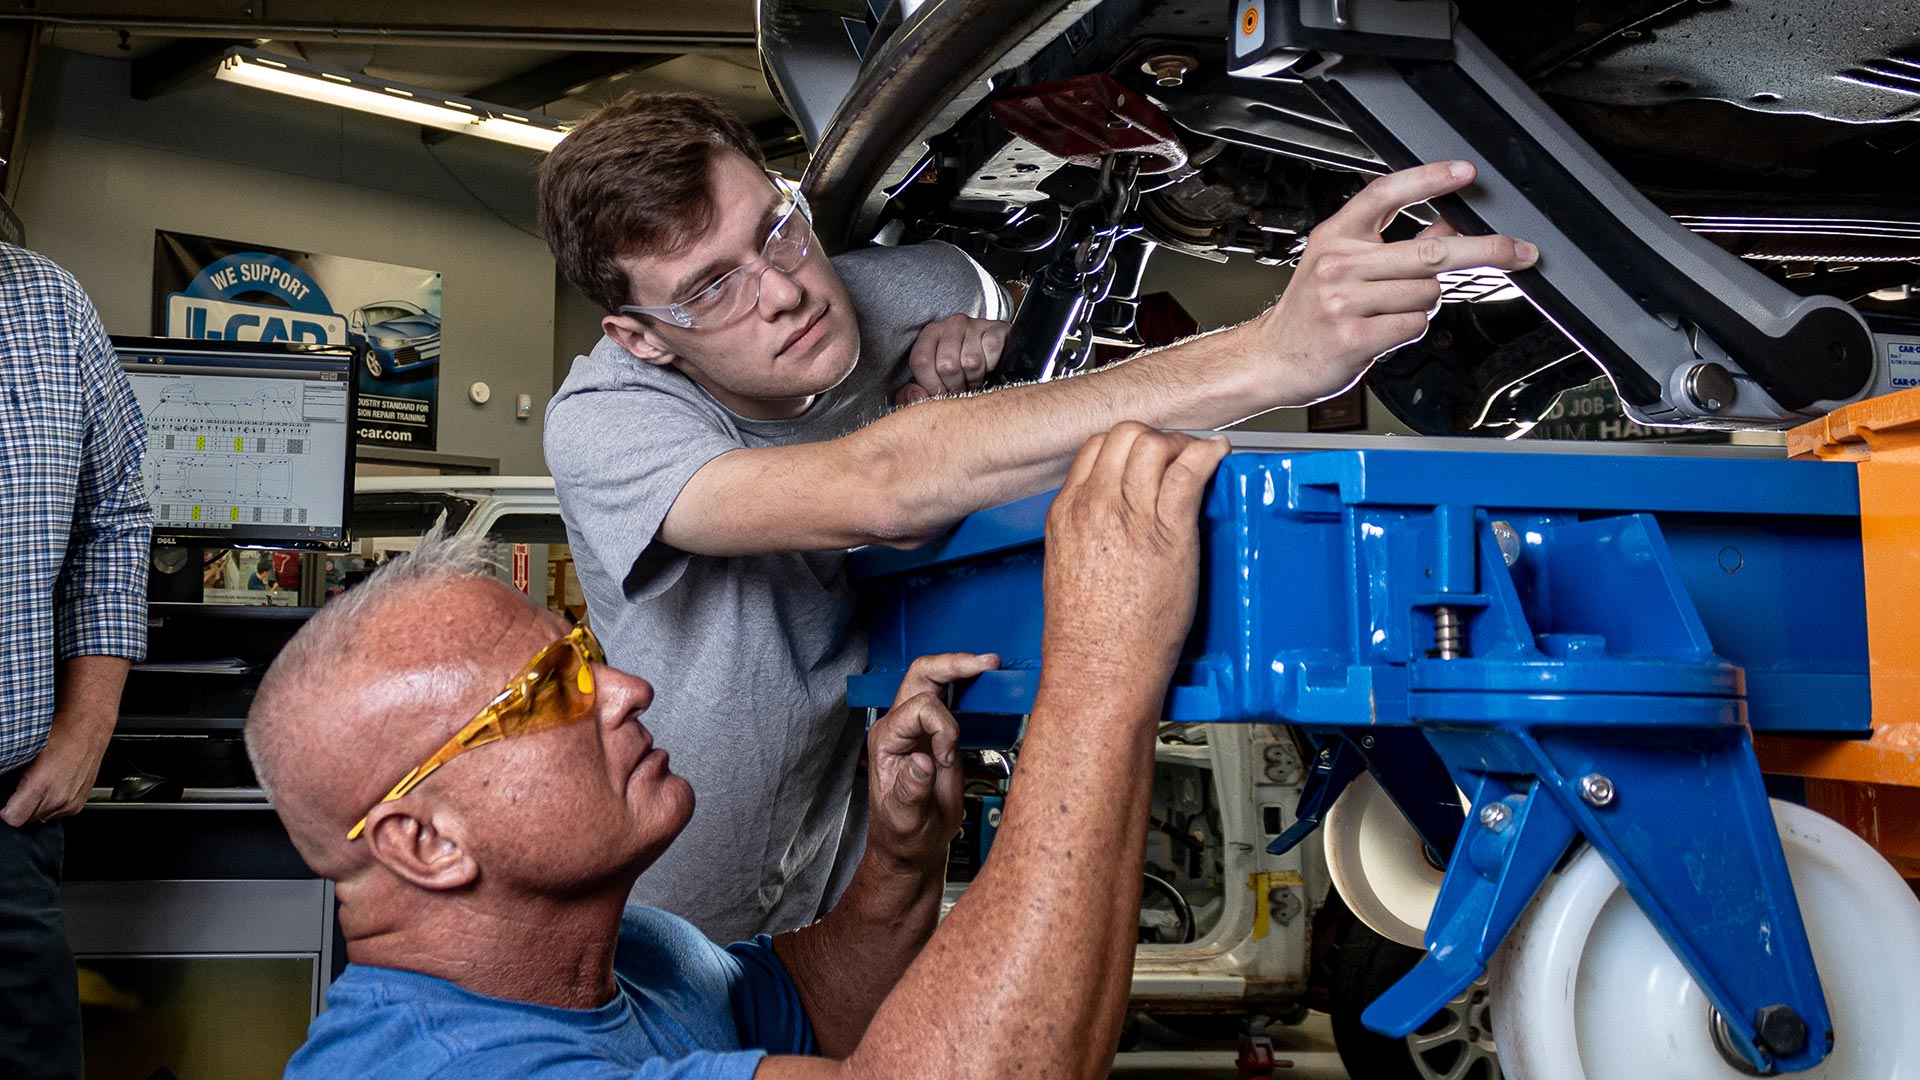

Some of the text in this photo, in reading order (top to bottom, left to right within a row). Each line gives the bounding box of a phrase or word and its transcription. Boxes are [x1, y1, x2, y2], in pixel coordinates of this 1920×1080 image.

[210, 263, 311, 300] WE SUPPORT
[381, 400, 415, 412] STANDARD
[416, 403, 429, 413] FOR
[372, 410, 395, 420] REPAIR
[396, 412, 426, 423] TRAINING
[157, 537, 177, 545] DELL
